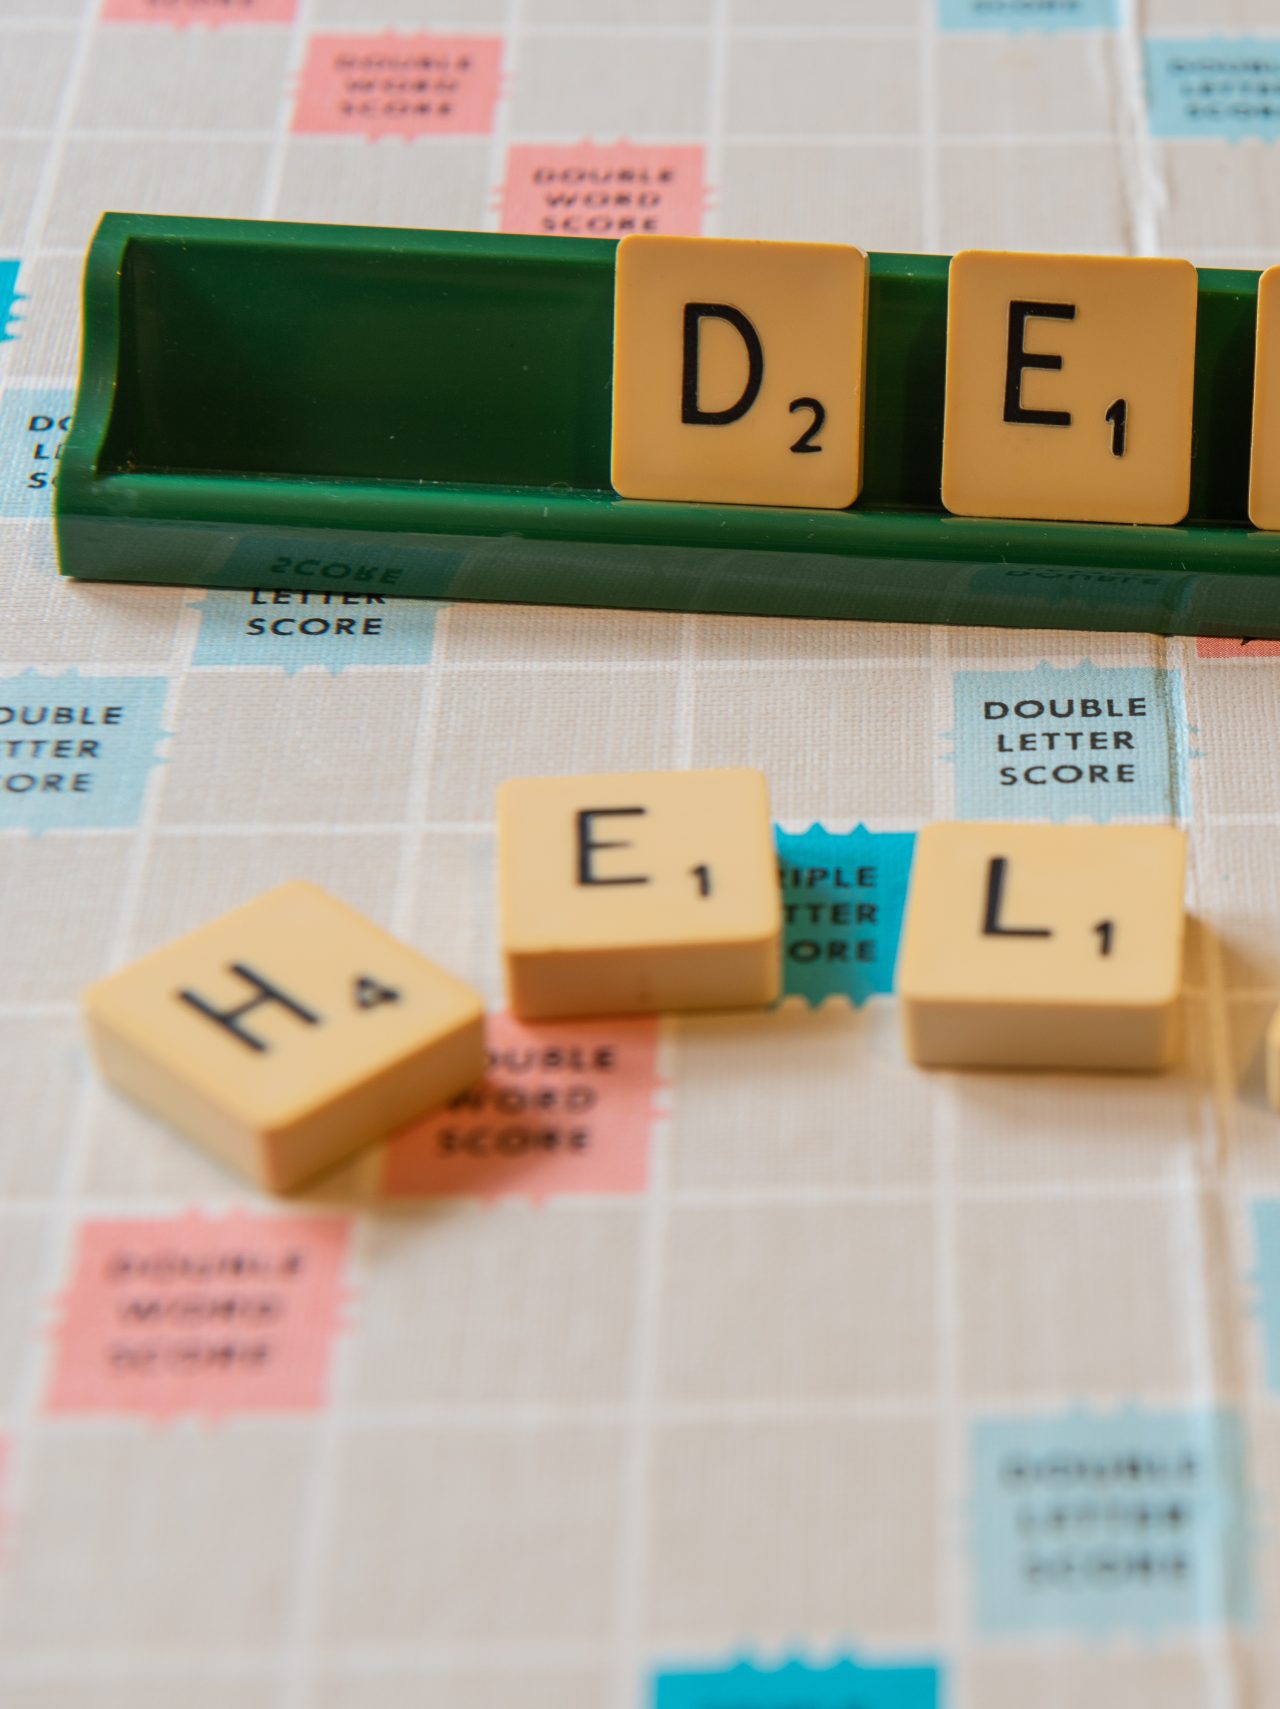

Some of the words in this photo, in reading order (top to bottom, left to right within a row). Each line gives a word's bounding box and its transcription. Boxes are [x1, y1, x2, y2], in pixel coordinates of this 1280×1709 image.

[246, 617, 383, 637] SCORE
[983, 696, 1147, 721] DOUBLE
[5, 738, 101, 759] TTER
[997, 730, 1135, 753] LETTER
[4, 772, 92, 794] ORE
[999, 763, 1135, 787] SCORE
[780, 864, 880, 891] IPLE
[783, 900, 880, 926] TTER
[786, 936, 880, 966] ORE
